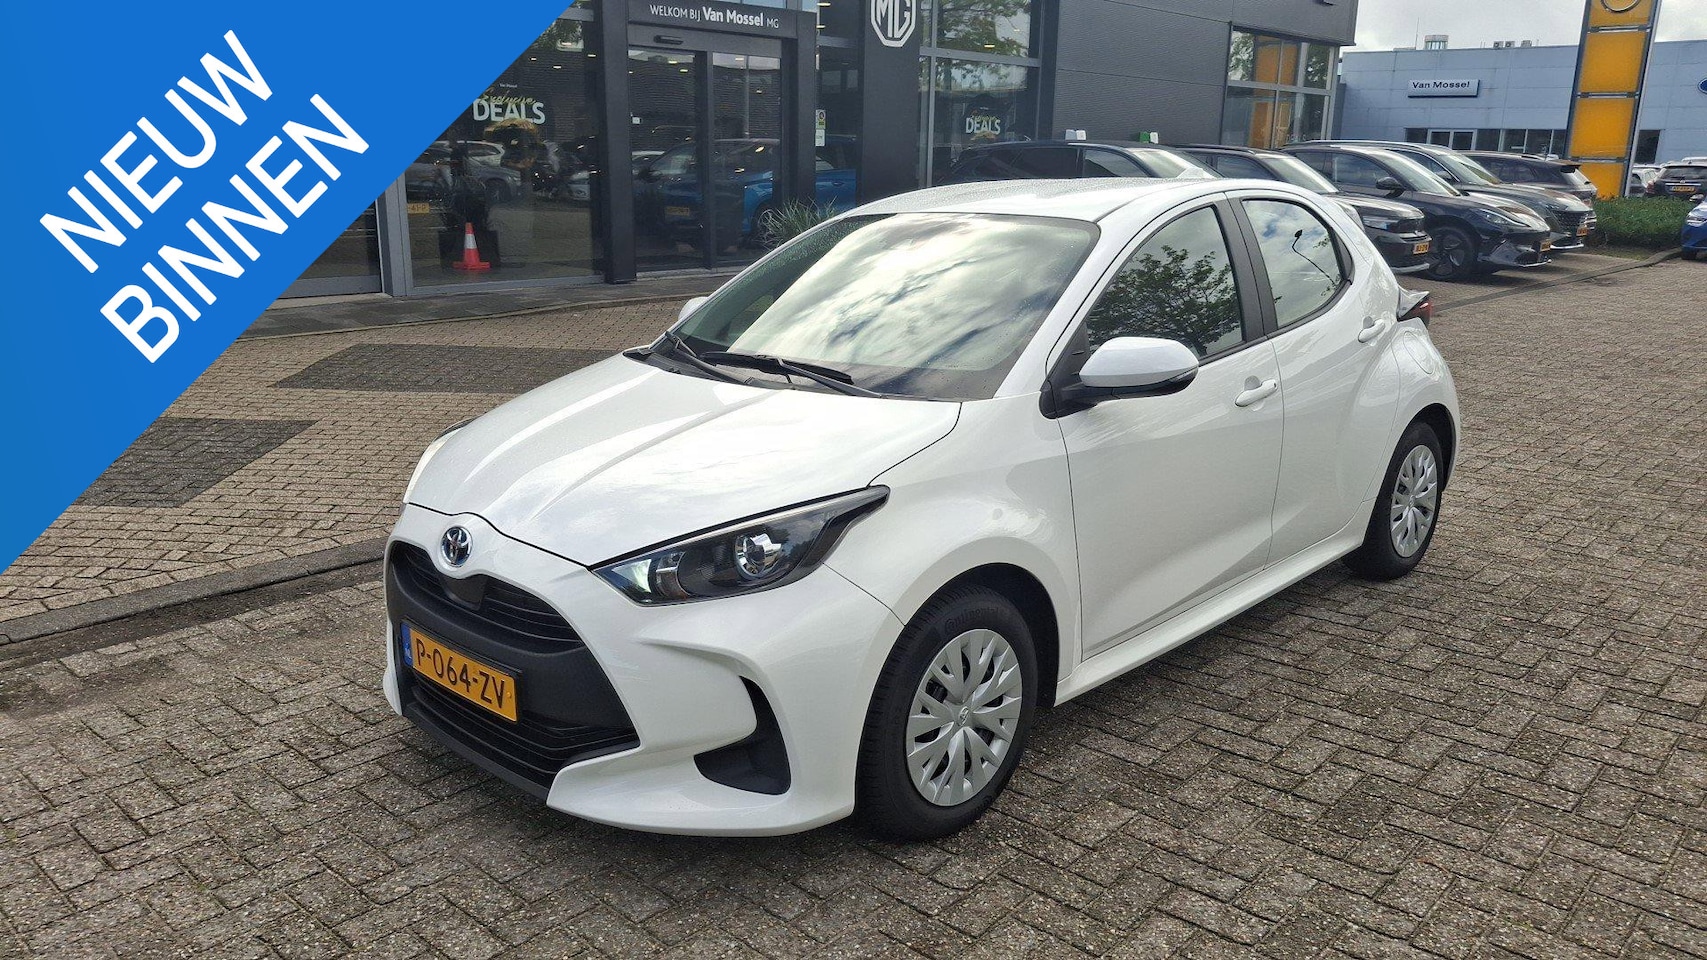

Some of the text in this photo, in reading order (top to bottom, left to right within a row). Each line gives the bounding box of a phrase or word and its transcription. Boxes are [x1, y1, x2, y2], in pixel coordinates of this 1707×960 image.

[650, 4, 779, 29] WELKOM BIJ Van Mossel MG
[876, 0, 911, 38] MG
[1432, 81, 1470, 89] Mossel
[473, 98, 546, 125] DEALS
[965, 117, 1001, 135] DEALS
[416, 637, 505, 709] P-064-ZV
